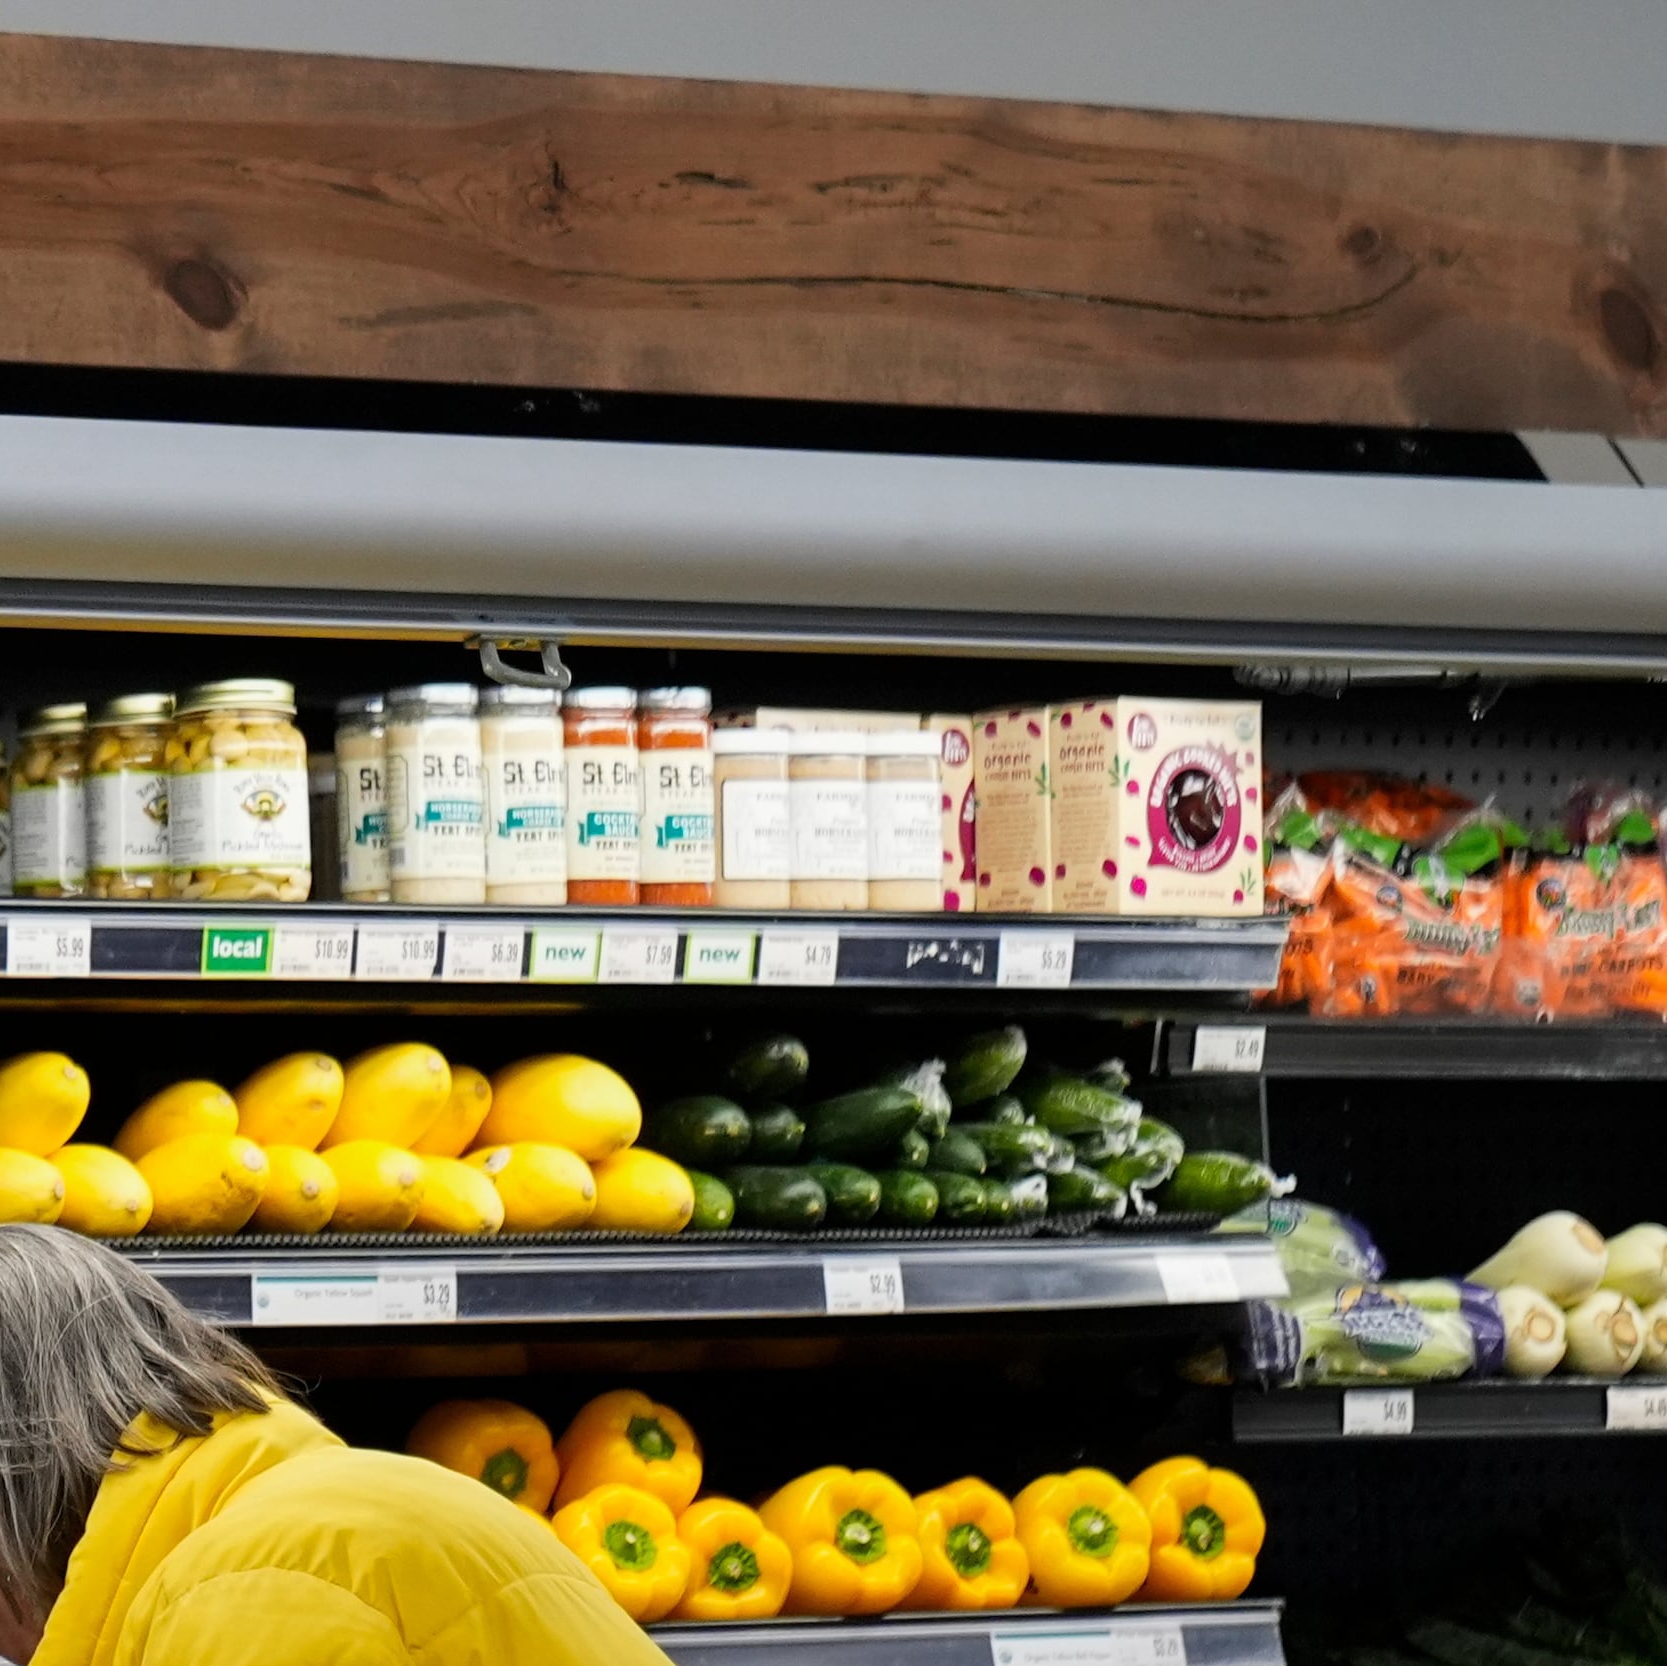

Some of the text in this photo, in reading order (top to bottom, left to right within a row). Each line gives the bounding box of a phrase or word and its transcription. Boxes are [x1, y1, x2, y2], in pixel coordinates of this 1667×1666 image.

[1059, 743, 1105, 760] organic
[984, 752, 1031, 770] organic
[56, 936, 85, 960] $5.99
[211, 934, 264, 959] local
[314, 937, 349, 962] $10.99
[401, 938, 437, 962] $10.99
[544, 944, 587, 961] new
[698, 946, 740, 962] new
